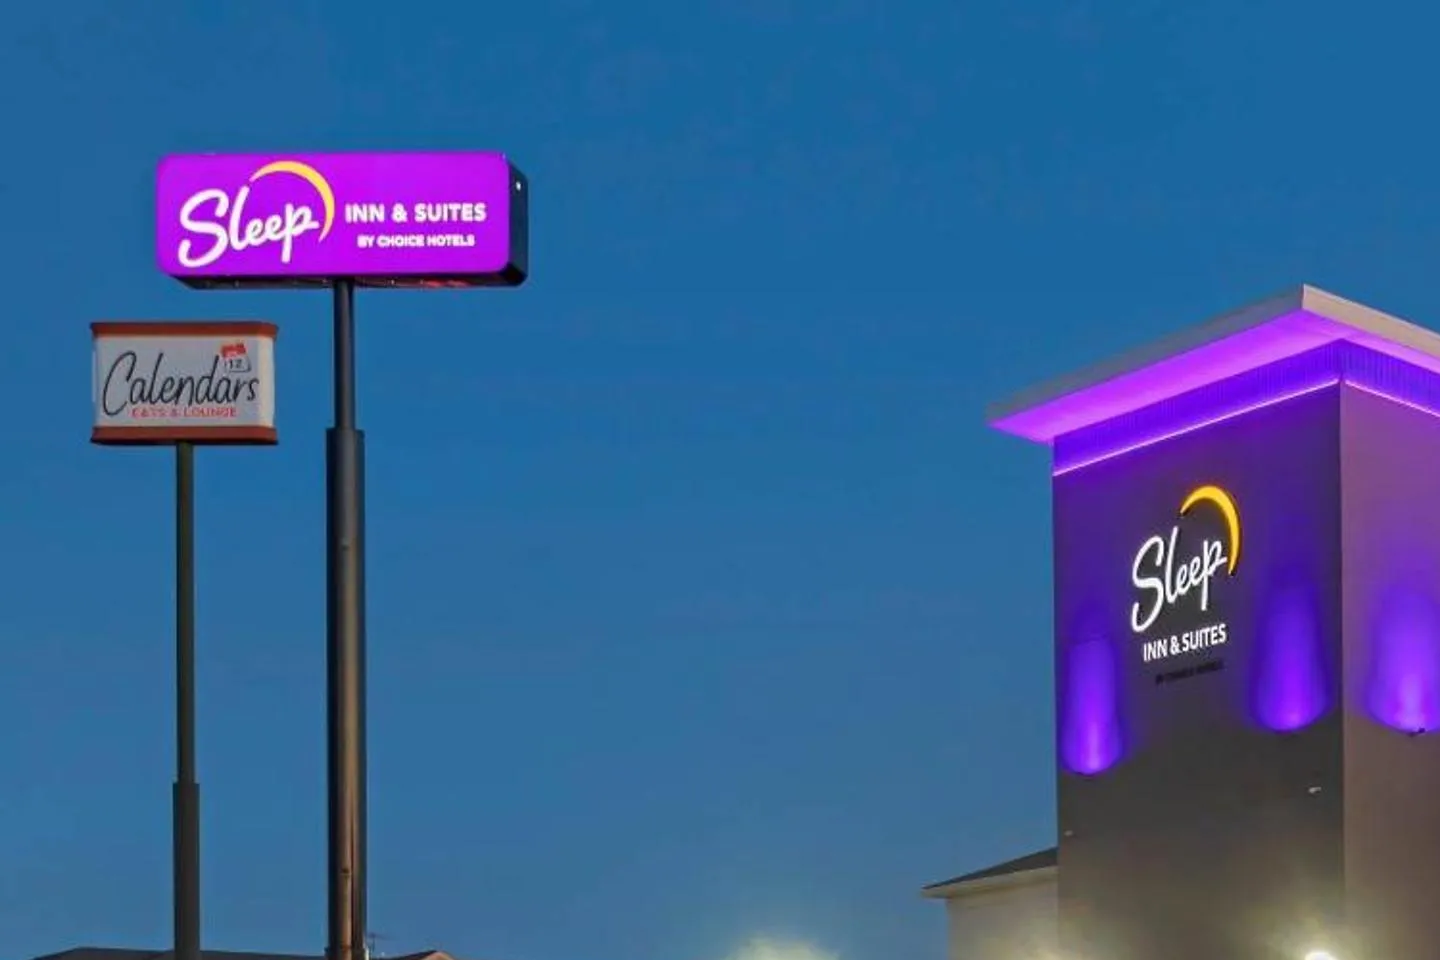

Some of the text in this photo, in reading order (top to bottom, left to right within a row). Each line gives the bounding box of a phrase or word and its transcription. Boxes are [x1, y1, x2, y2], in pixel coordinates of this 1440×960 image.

[178, 186, 319, 268] Sleep
[344, 202, 487, 222] INN & SUITES
[357, 234, 475, 247] BY CHOICE HOTELS
[103, 350, 260, 416] Calendars
[183, 407, 237, 418] LOUNGE
[1131, 525, 1227, 632] Sleep
[1143, 623, 1226, 662] INN & SUITES
